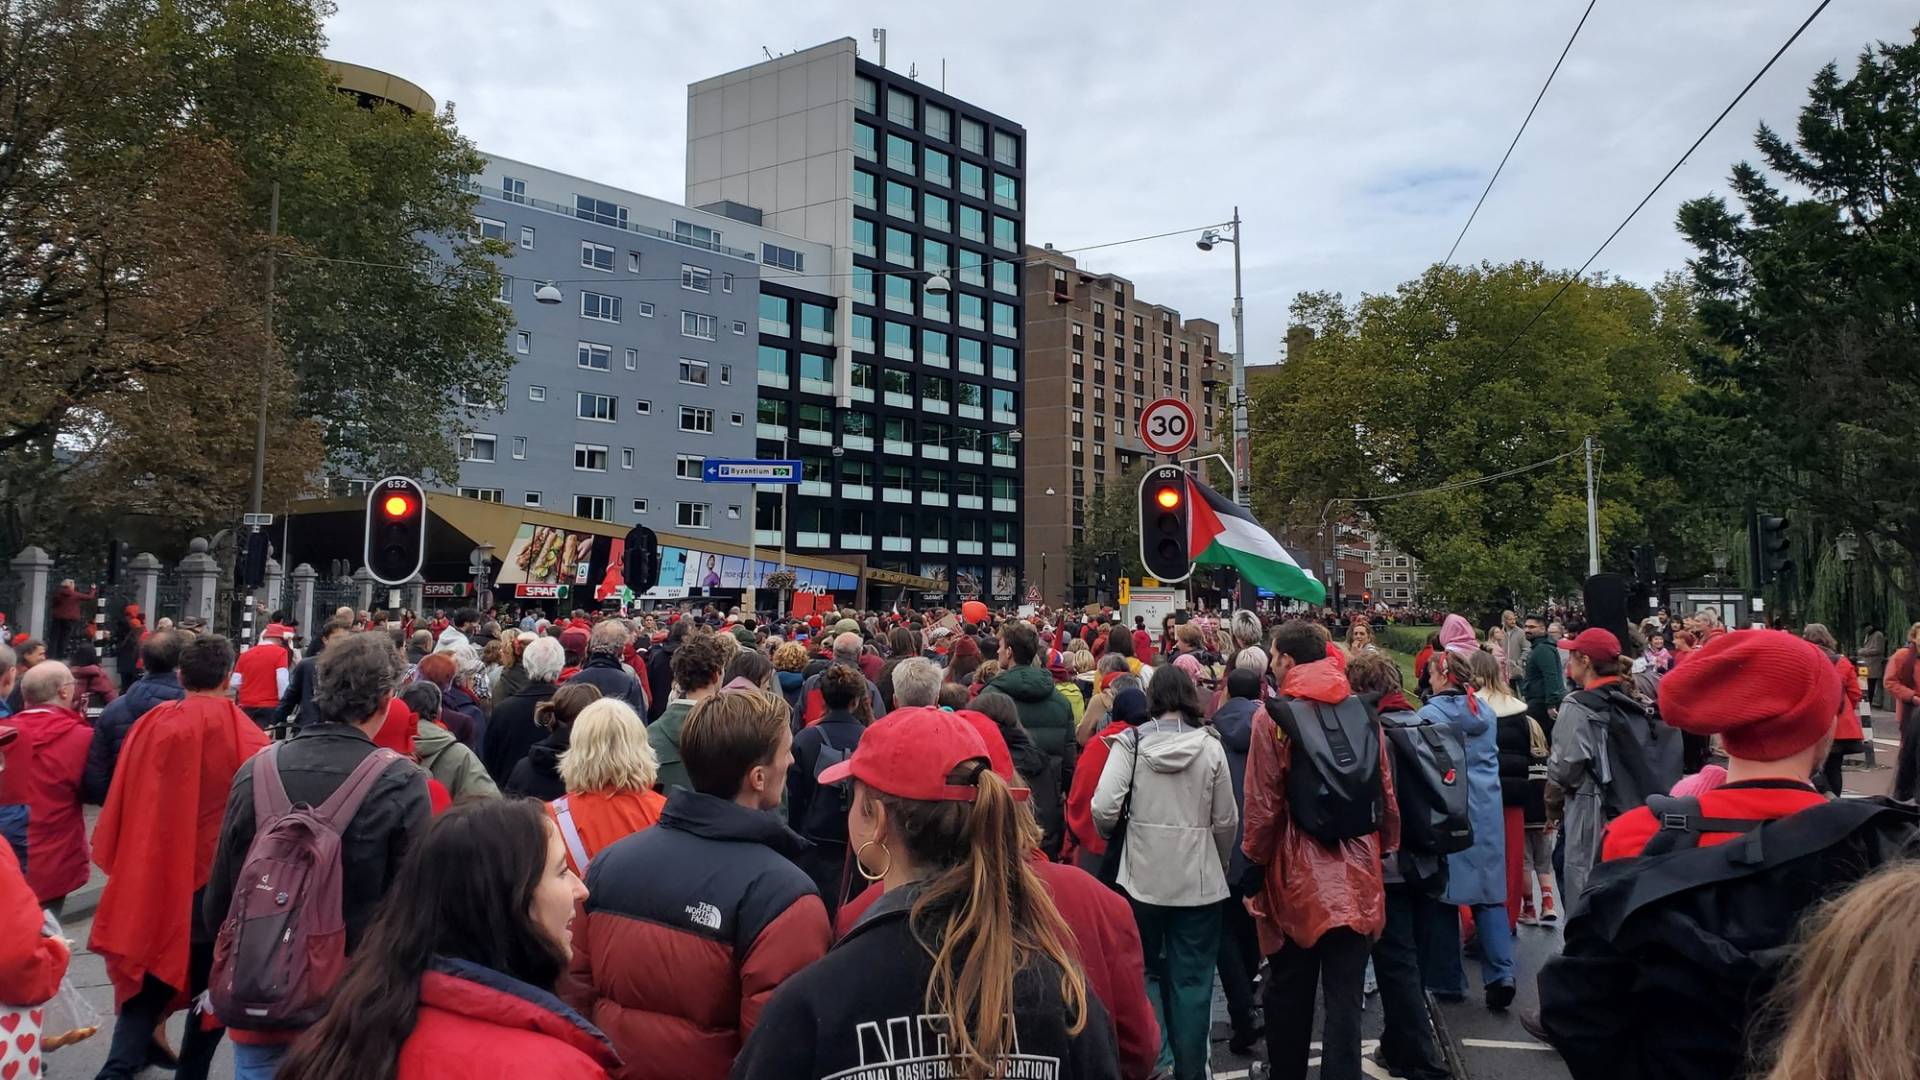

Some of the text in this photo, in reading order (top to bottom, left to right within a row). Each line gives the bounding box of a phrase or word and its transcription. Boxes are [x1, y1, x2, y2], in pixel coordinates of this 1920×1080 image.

[1151, 415, 1185, 436] 30
[1159, 469, 1177, 478] 651
[387, 480, 407, 489] 652
[425, 585, 454, 595] SPAR
[525, 586, 558, 597] SPAR
[685, 905, 710, 919] NORTH
[698, 901, 713, 912] THE
[690, 914, 709, 925] FACE
